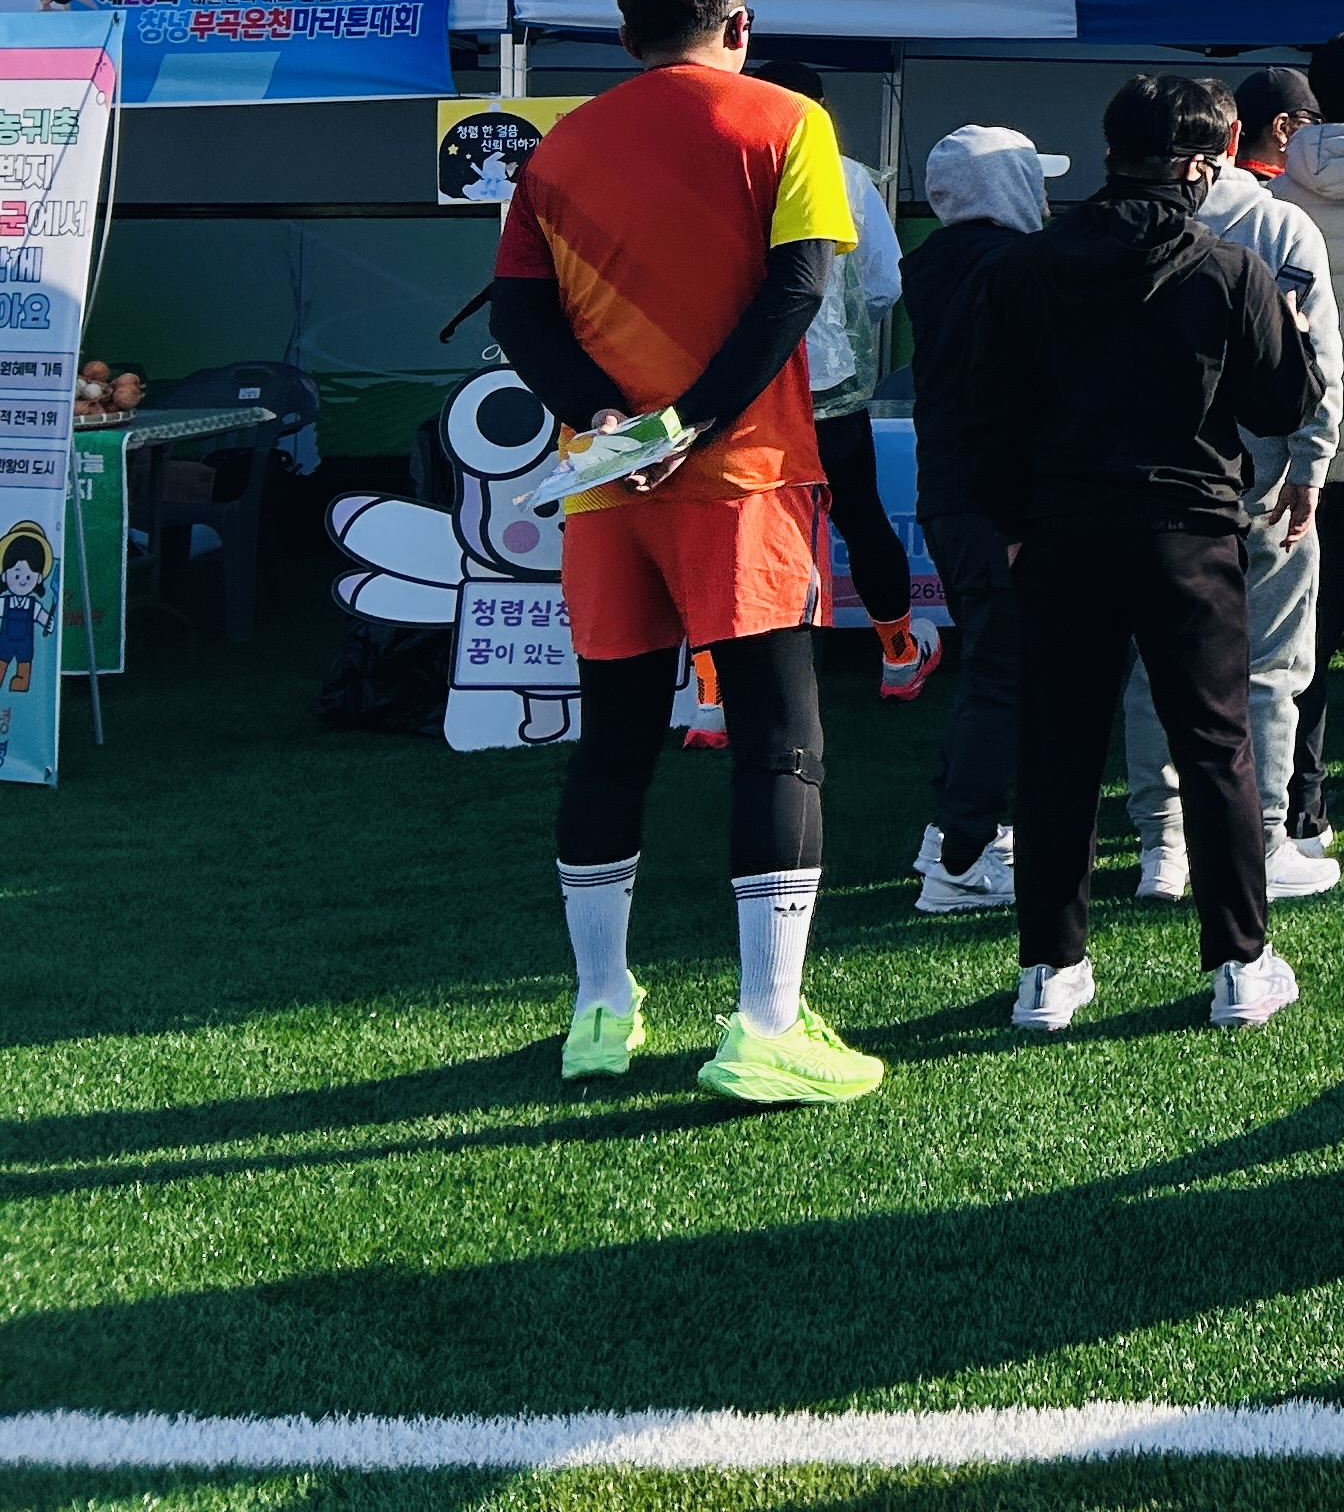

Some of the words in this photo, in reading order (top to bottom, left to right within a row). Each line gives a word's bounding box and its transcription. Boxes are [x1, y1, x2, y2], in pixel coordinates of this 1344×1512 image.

[456, 125, 479, 140] 청렴
[481, 124, 494, 139] 한
[496, 124, 519, 138] 걸음
[480, 138, 503, 153] 신뢰
[41, 362, 63, 378] 가득
[14, 410, 38, 427] 전국
[41, 411, 58, 427] 1위
[31, 460, 56, 475] 도시
[466, 638, 515, 665] 꿈이
[523, 642, 566, 665] 있는
